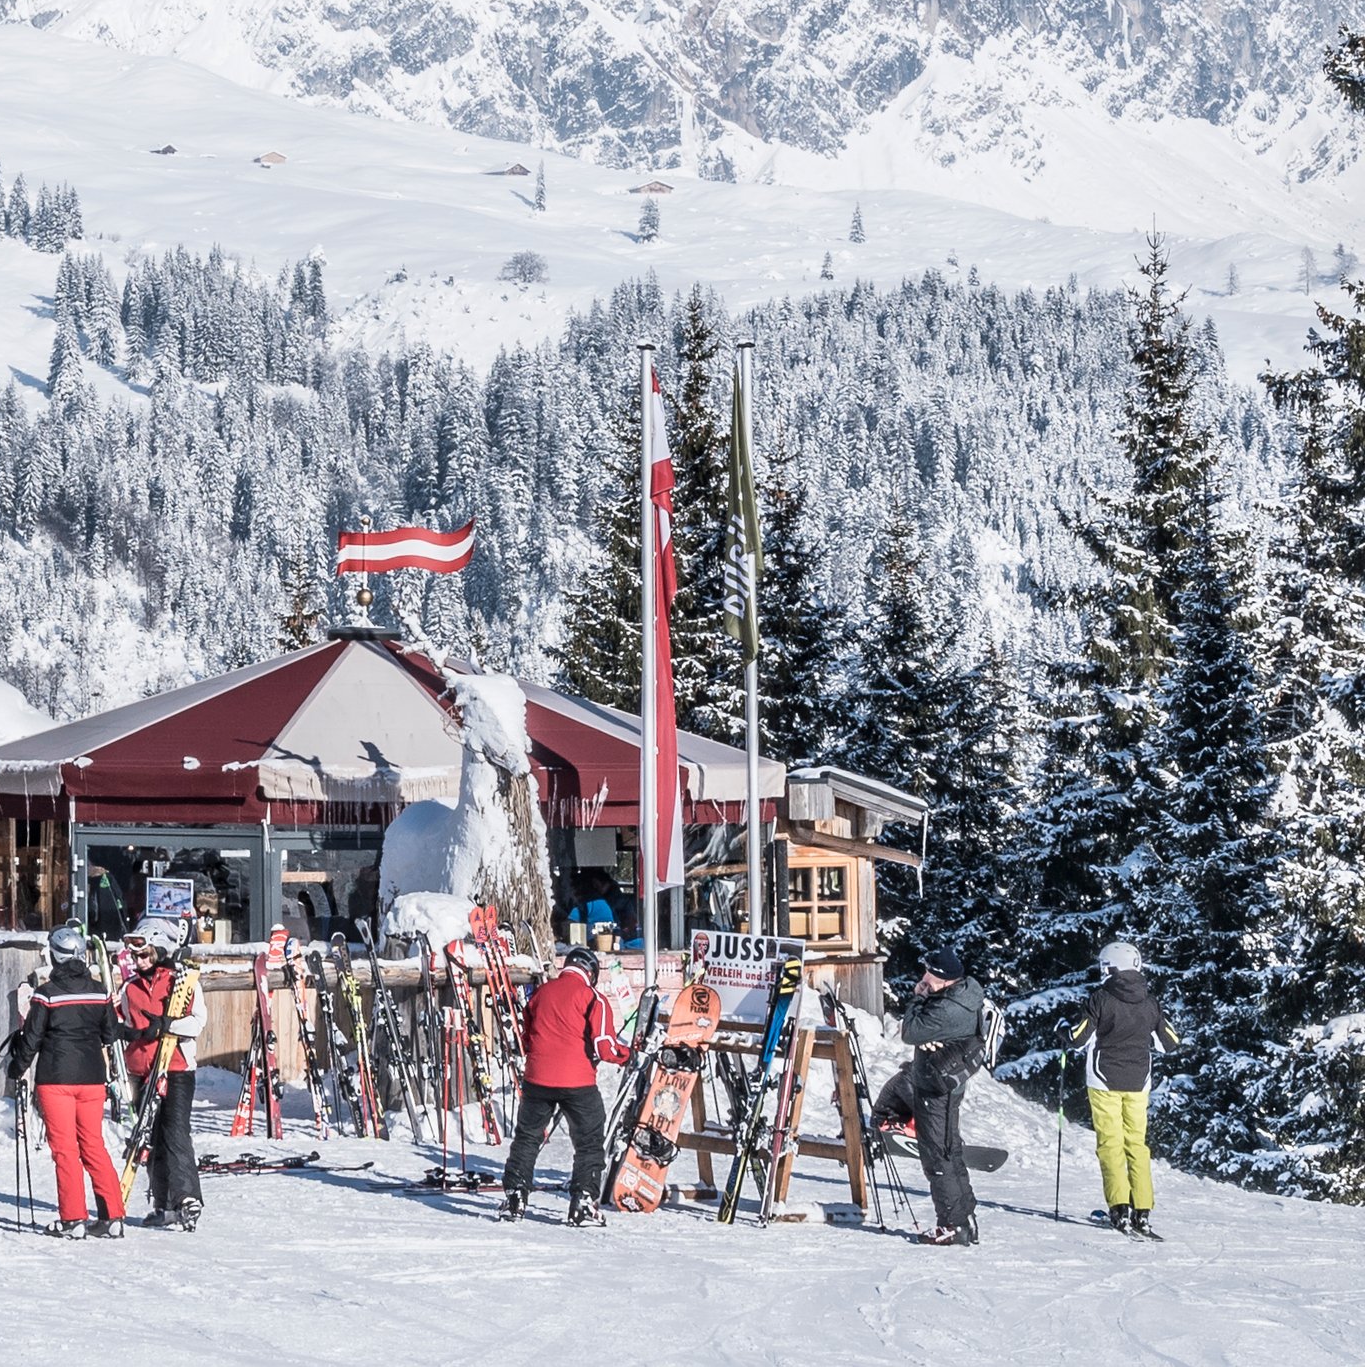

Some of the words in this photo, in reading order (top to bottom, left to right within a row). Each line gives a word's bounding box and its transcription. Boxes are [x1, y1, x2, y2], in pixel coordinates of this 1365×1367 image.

[707, 967, 742, 979] VERLEIH
[745, 971, 762, 981] und
[658, 1072, 690, 1091] FLOW
